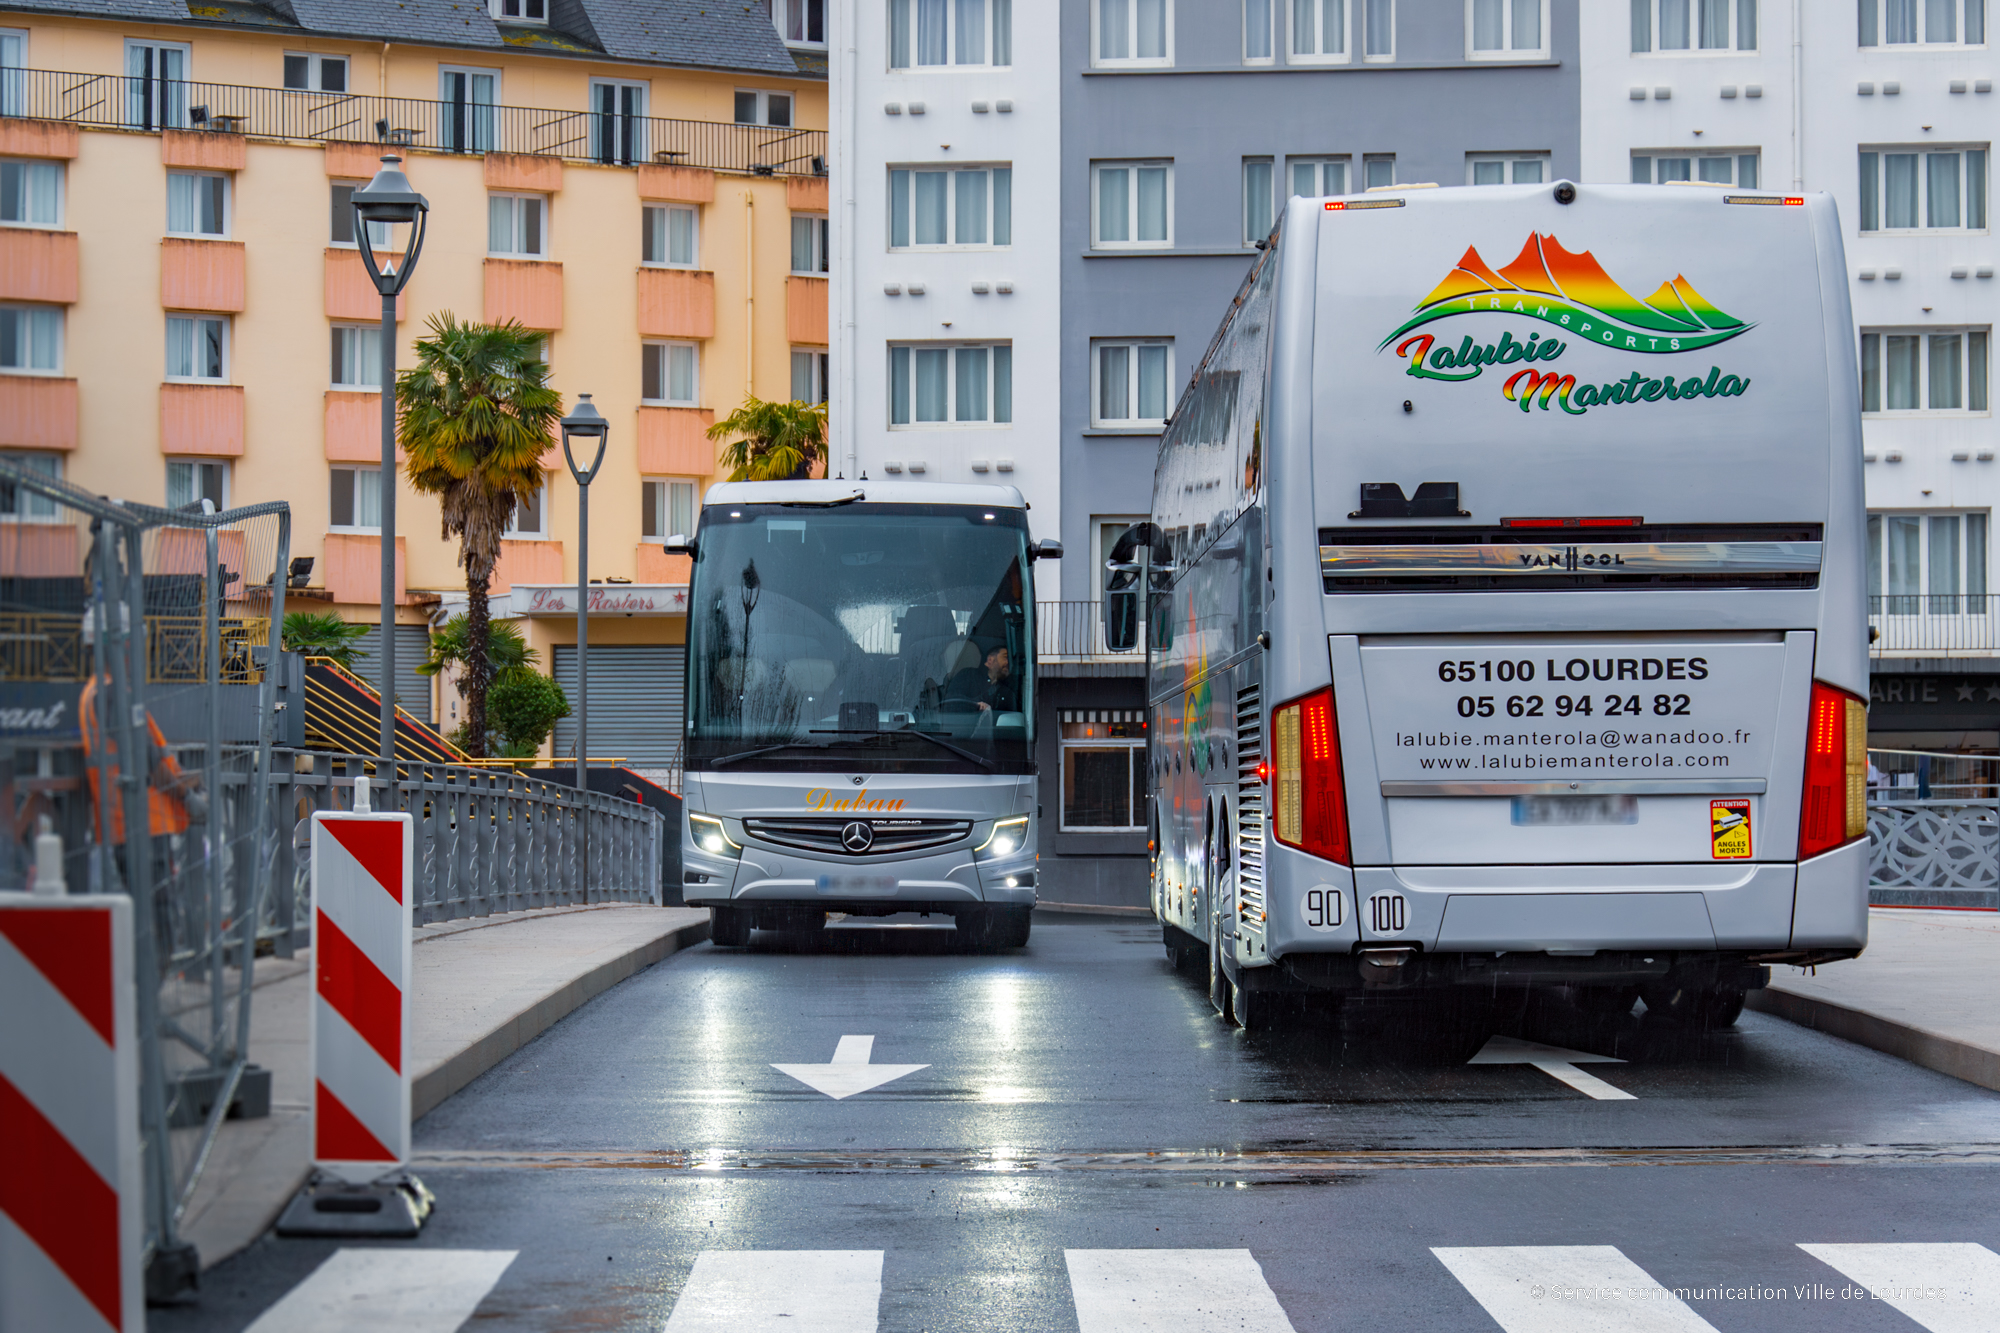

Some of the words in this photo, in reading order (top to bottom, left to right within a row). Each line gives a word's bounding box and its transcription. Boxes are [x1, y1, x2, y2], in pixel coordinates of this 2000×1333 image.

[1466, 297, 1681, 351] TRANSPORTS
[1396, 331, 1568, 382] Lalubie
[1502, 365, 1751, 415] Manterola
[529, 588, 566, 611] Les
[586, 588, 655, 611] Rosiers
[1438, 660, 1536, 683] 65100
[1547, 657, 1710, 682] LOURDES
[1457, 695, 1496, 718] 05
[1506, 695, 1545, 717] 62
[1555, 694, 1594, 717] 94
[1604, 694, 1643, 716] 24
[1653, 693, 1692, 716] 82
[1396, 729, 1752, 749] lalubie.manterola@wanadoo.fr
[1420, 752, 1730, 770] www.lalubiemanterola.com
[805, 787, 911, 813] Dubau
[1712, 800, 1749, 808] ATTENTION
[1717, 840, 1747, 848] ANGLES
[1308, 889, 1342, 927] 90
[1369, 895, 1405, 932] 100
